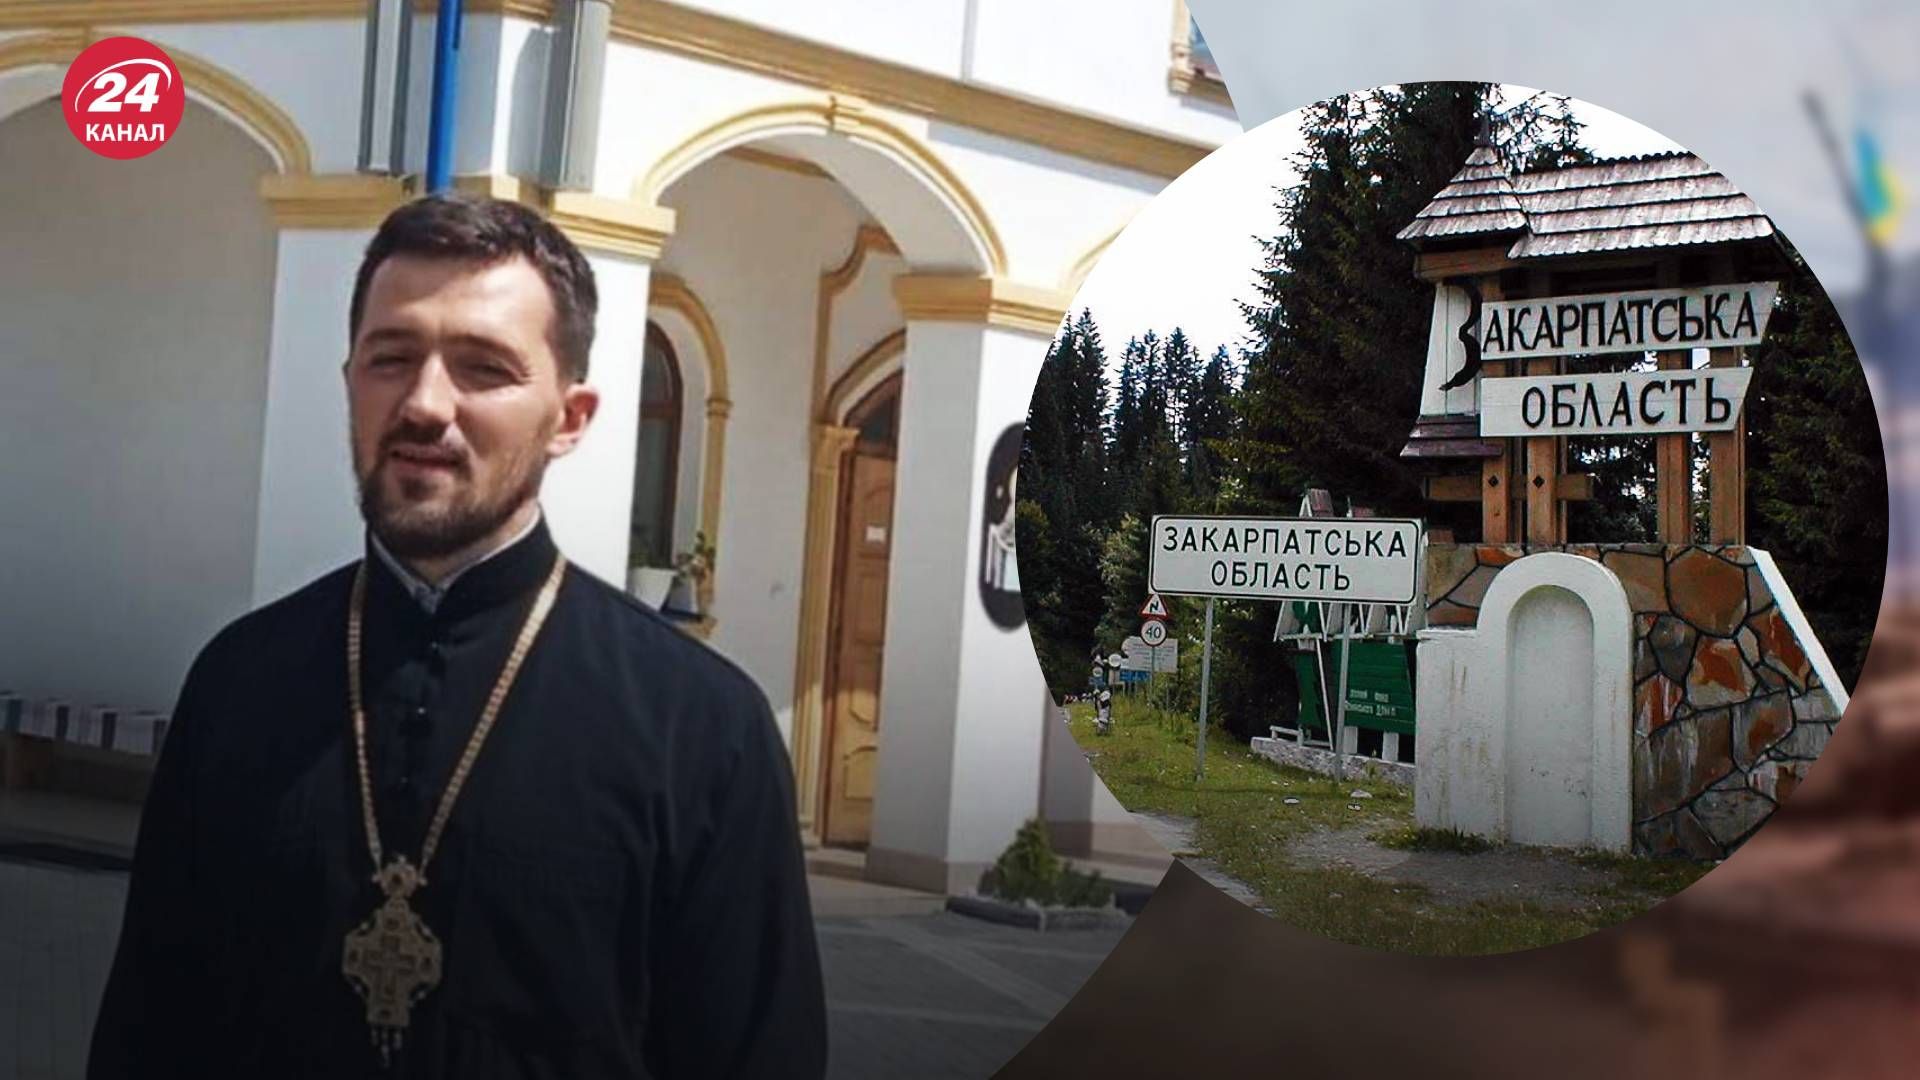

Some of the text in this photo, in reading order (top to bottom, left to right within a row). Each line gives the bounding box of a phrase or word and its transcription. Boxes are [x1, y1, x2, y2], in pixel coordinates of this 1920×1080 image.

[1439, 282, 1759, 391] ЗАКАРПАТСЬКА
[1521, 376, 1732, 429] ОБЛАСТЬ
[1162, 526, 1407, 558] ЗАКАРПАТСЬКА
[1210, 560, 1350, 591] ОБЛАСТЬ
[1145, 626, 1162, 639] 40
